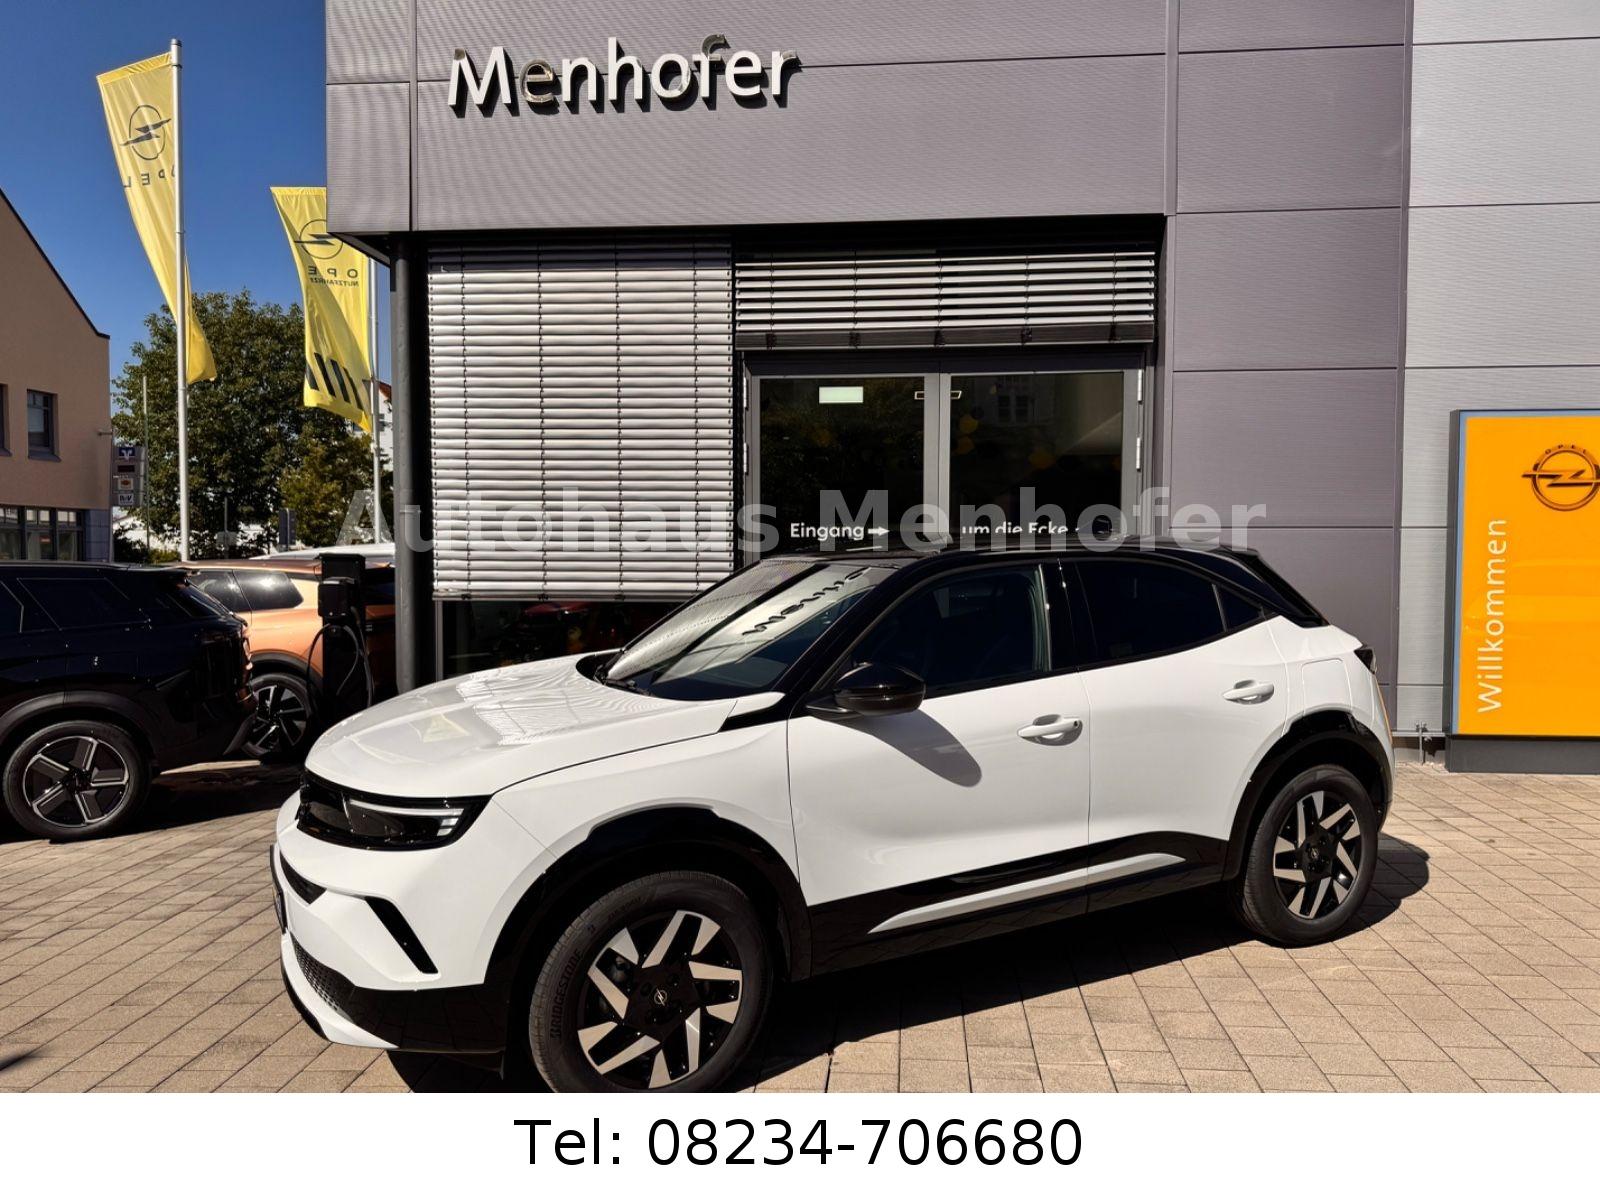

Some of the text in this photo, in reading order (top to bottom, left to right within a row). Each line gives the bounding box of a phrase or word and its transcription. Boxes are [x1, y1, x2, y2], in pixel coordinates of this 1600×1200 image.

[448, 34, 797, 105] Menhofer
[790, 522, 865, 541] Eingang
[1477, 519, 1508, 713] Willkommen
